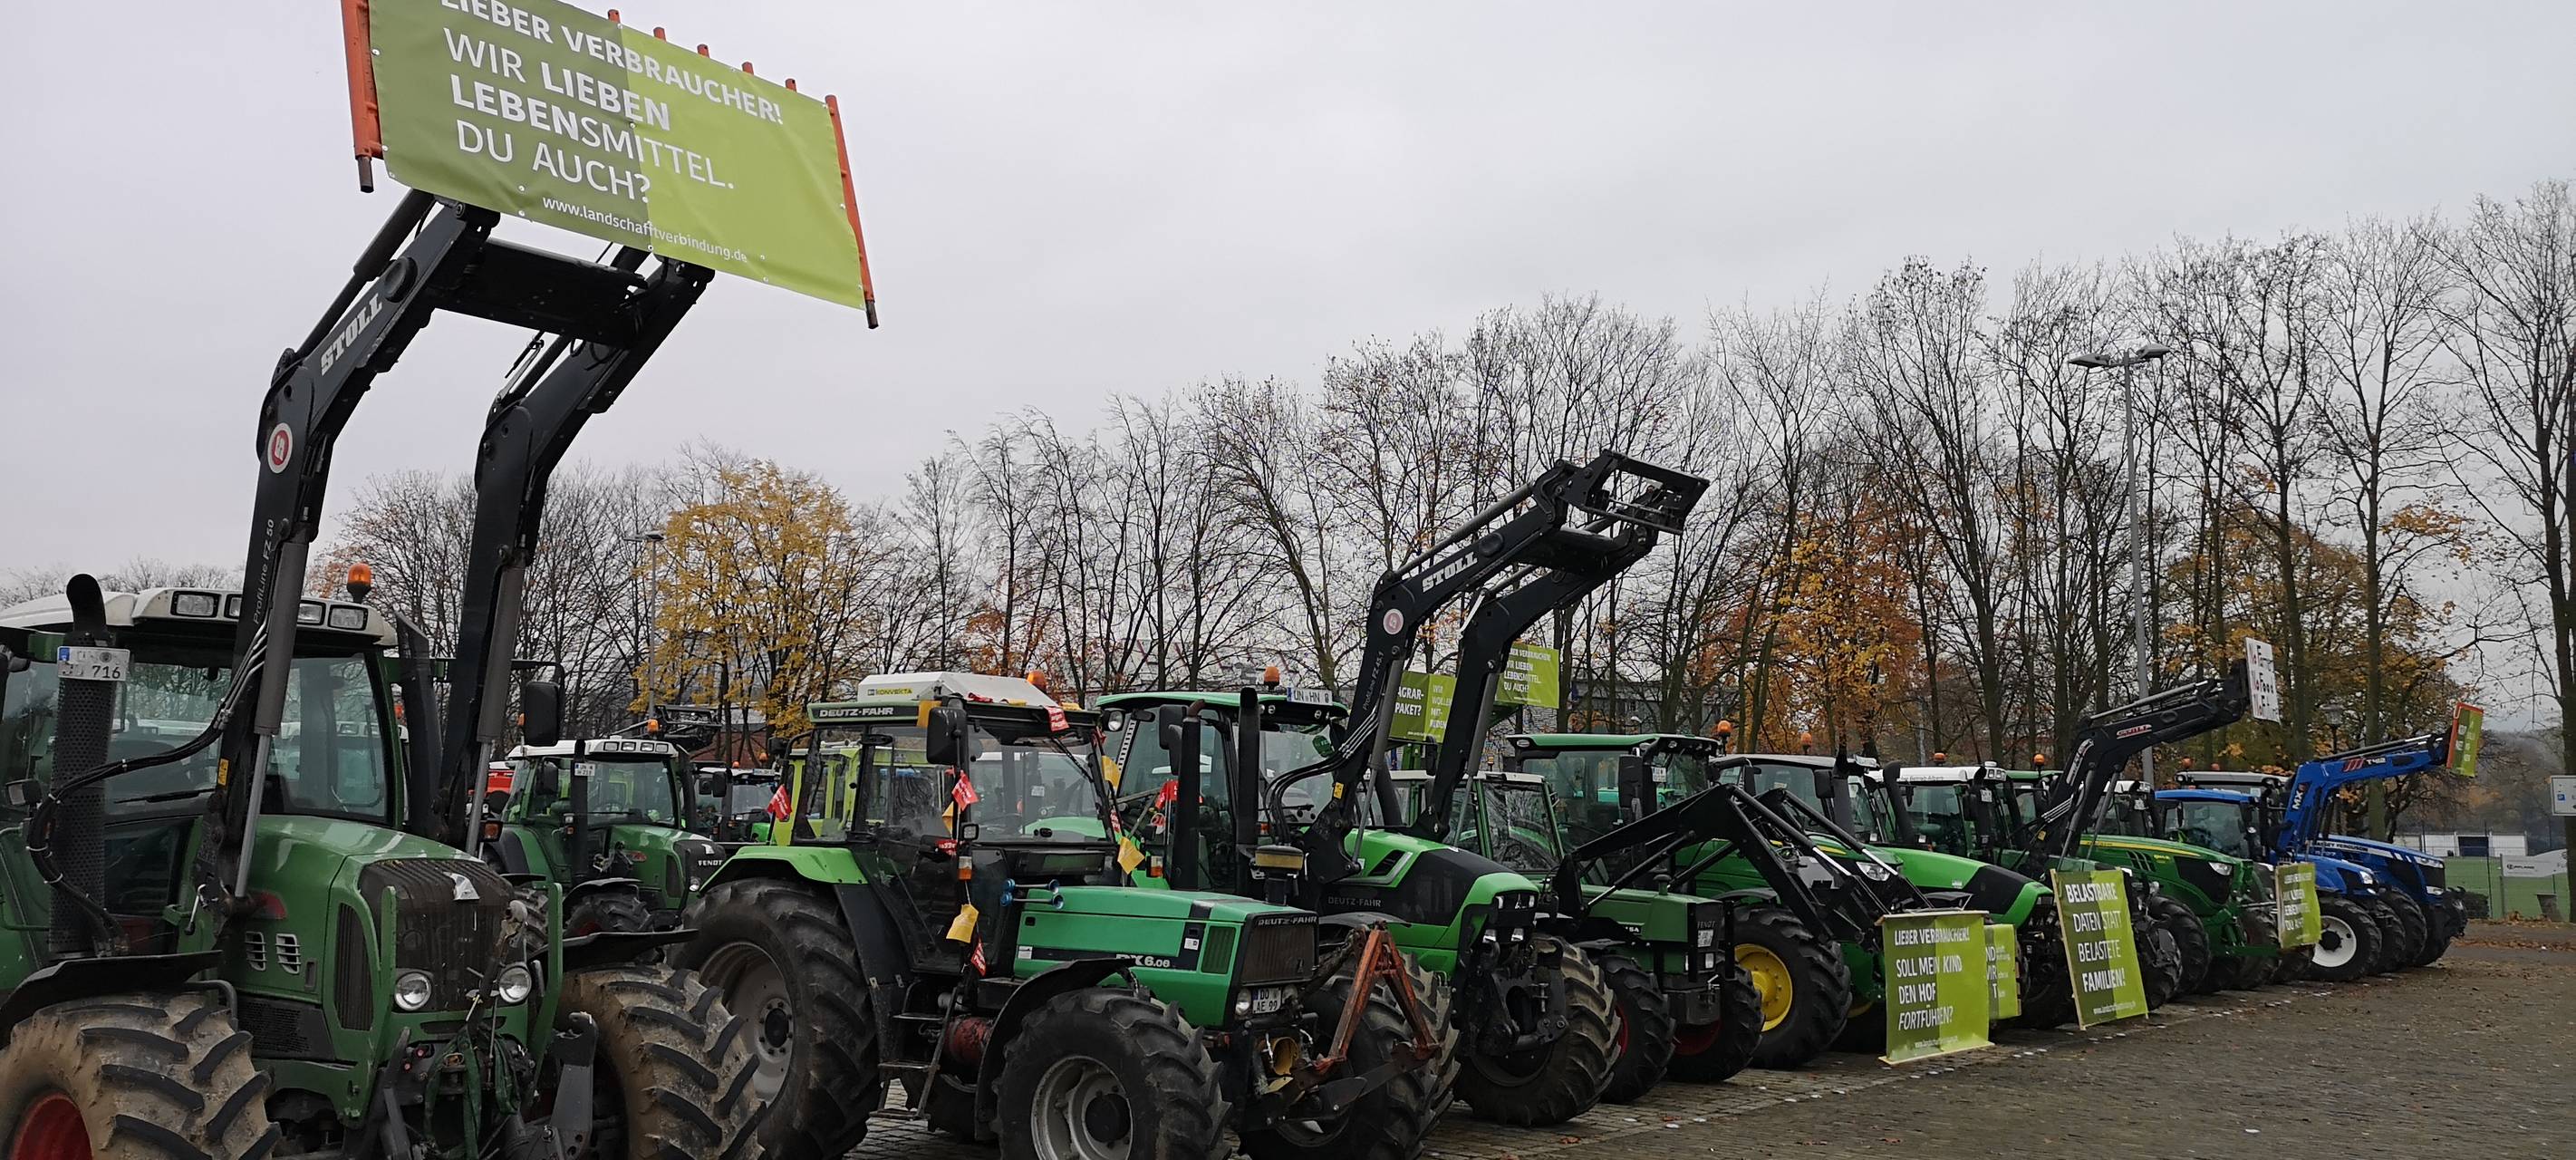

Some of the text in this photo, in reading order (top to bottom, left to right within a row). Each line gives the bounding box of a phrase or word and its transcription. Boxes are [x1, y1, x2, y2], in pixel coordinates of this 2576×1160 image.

[443, 27, 671, 131] WIR LIEBEN
[561, 24, 784, 125] VERBRAUCHER!
[450, 73, 735, 189] LEBENSMITTEL.
[457, 119, 651, 204] DU AUCH?
[543, 196, 748, 264] www.landschafftverbindung.de
[320, 293, 383, 376] STOLL
[266, 518, 275, 537] 50
[263, 539, 272, 560] FZ
[1421, 551, 1478, 594] STOLL
[92, 663, 121, 680] 716
[1394, 701, 1423, 717] PAKET?
[2291, 790, 2304, 810] MX
[2065, 882, 2118, 904] BELASTBARE
[2072, 910, 2122, 933] DATEN STATT
[1895, 926, 1970, 946] LIEBER VERBRAUCHER!
[2078, 939, 2122, 963] BELASTETE
[1896, 959, 1917, 978] SOLL
[1943, 955, 1963, 973] KIND
[2082, 967, 2126, 993] FAMILIEN!
[1898, 982, 1936, 1004] DEN HOF
[1898, 1004, 1954, 1031] FORTFÜHREN?
